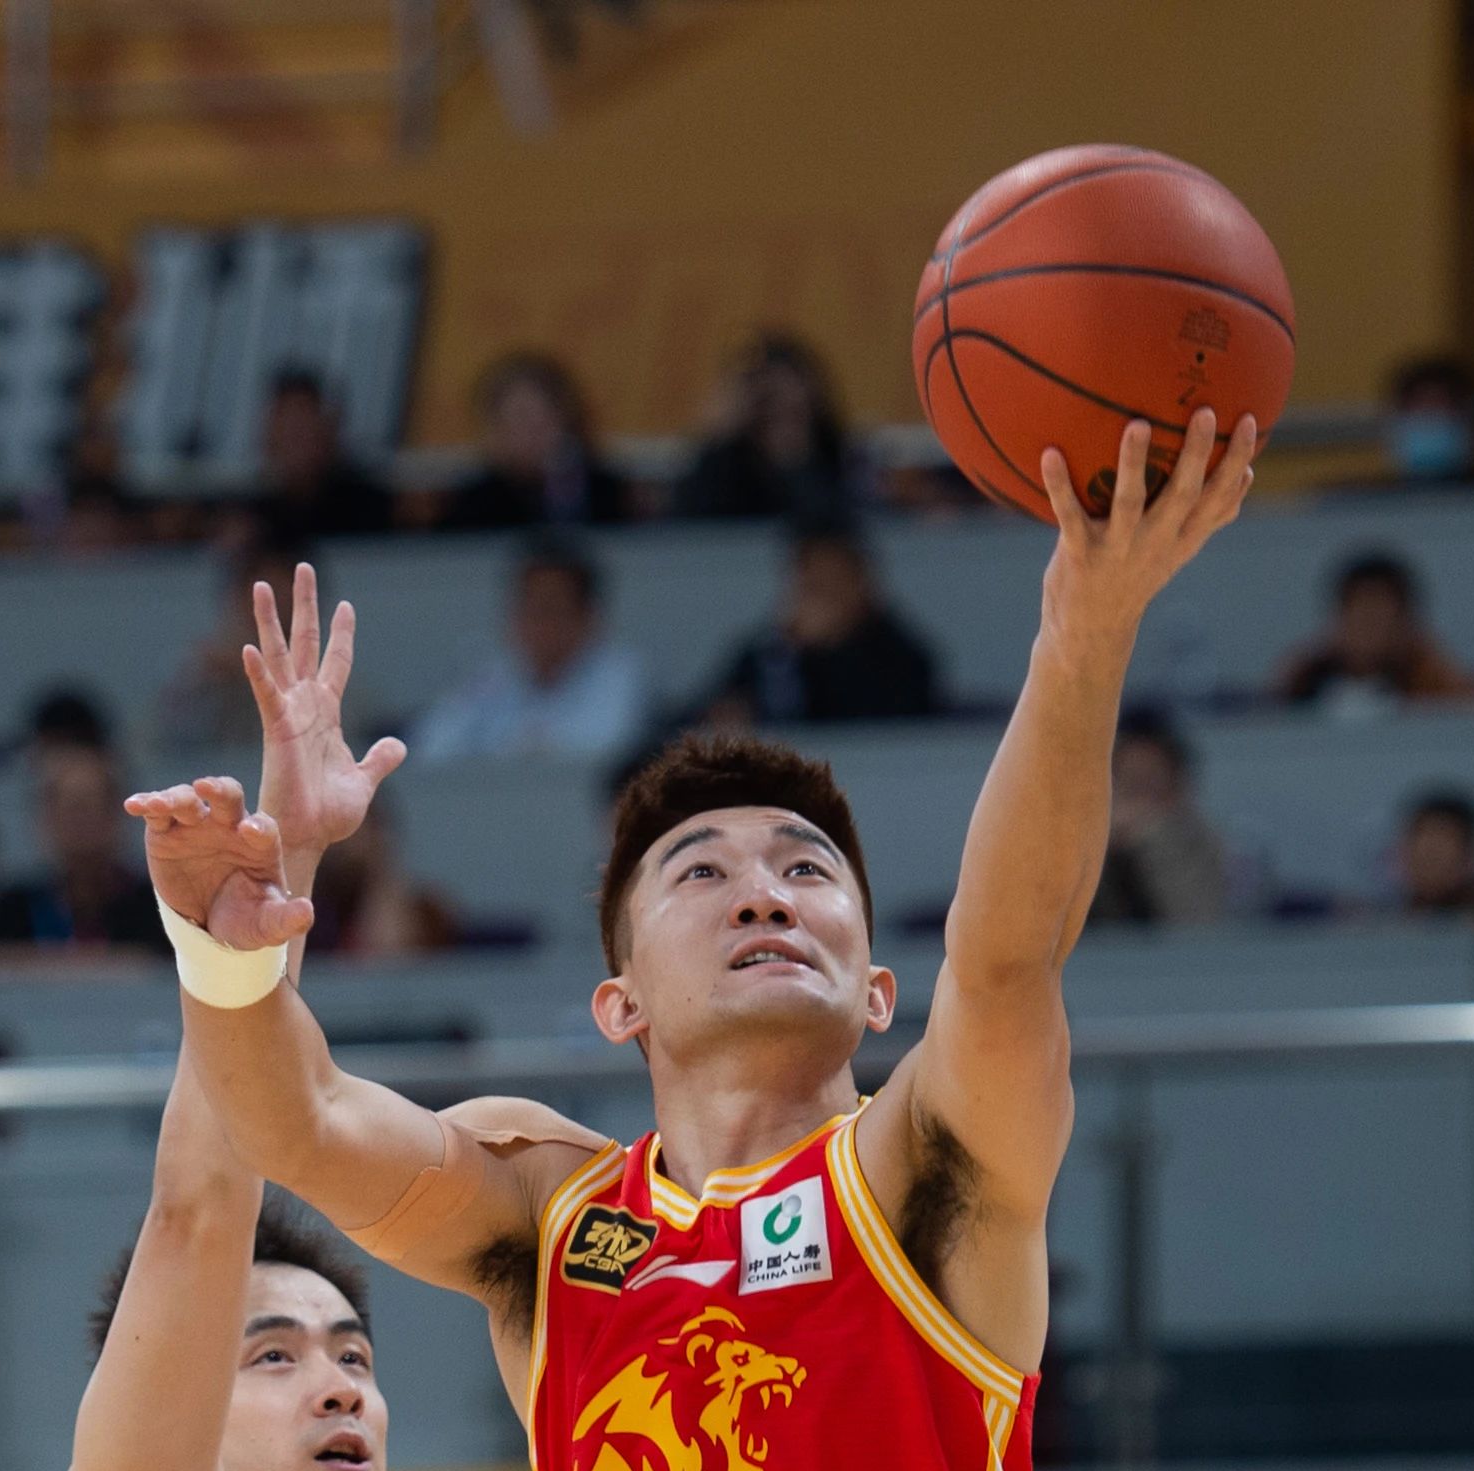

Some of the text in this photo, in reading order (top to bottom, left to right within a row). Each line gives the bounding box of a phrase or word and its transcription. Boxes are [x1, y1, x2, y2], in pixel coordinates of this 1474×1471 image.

[748, 1243, 821, 1273] 中国人寿
[747, 1261, 822, 1284] CHINA LIFE
